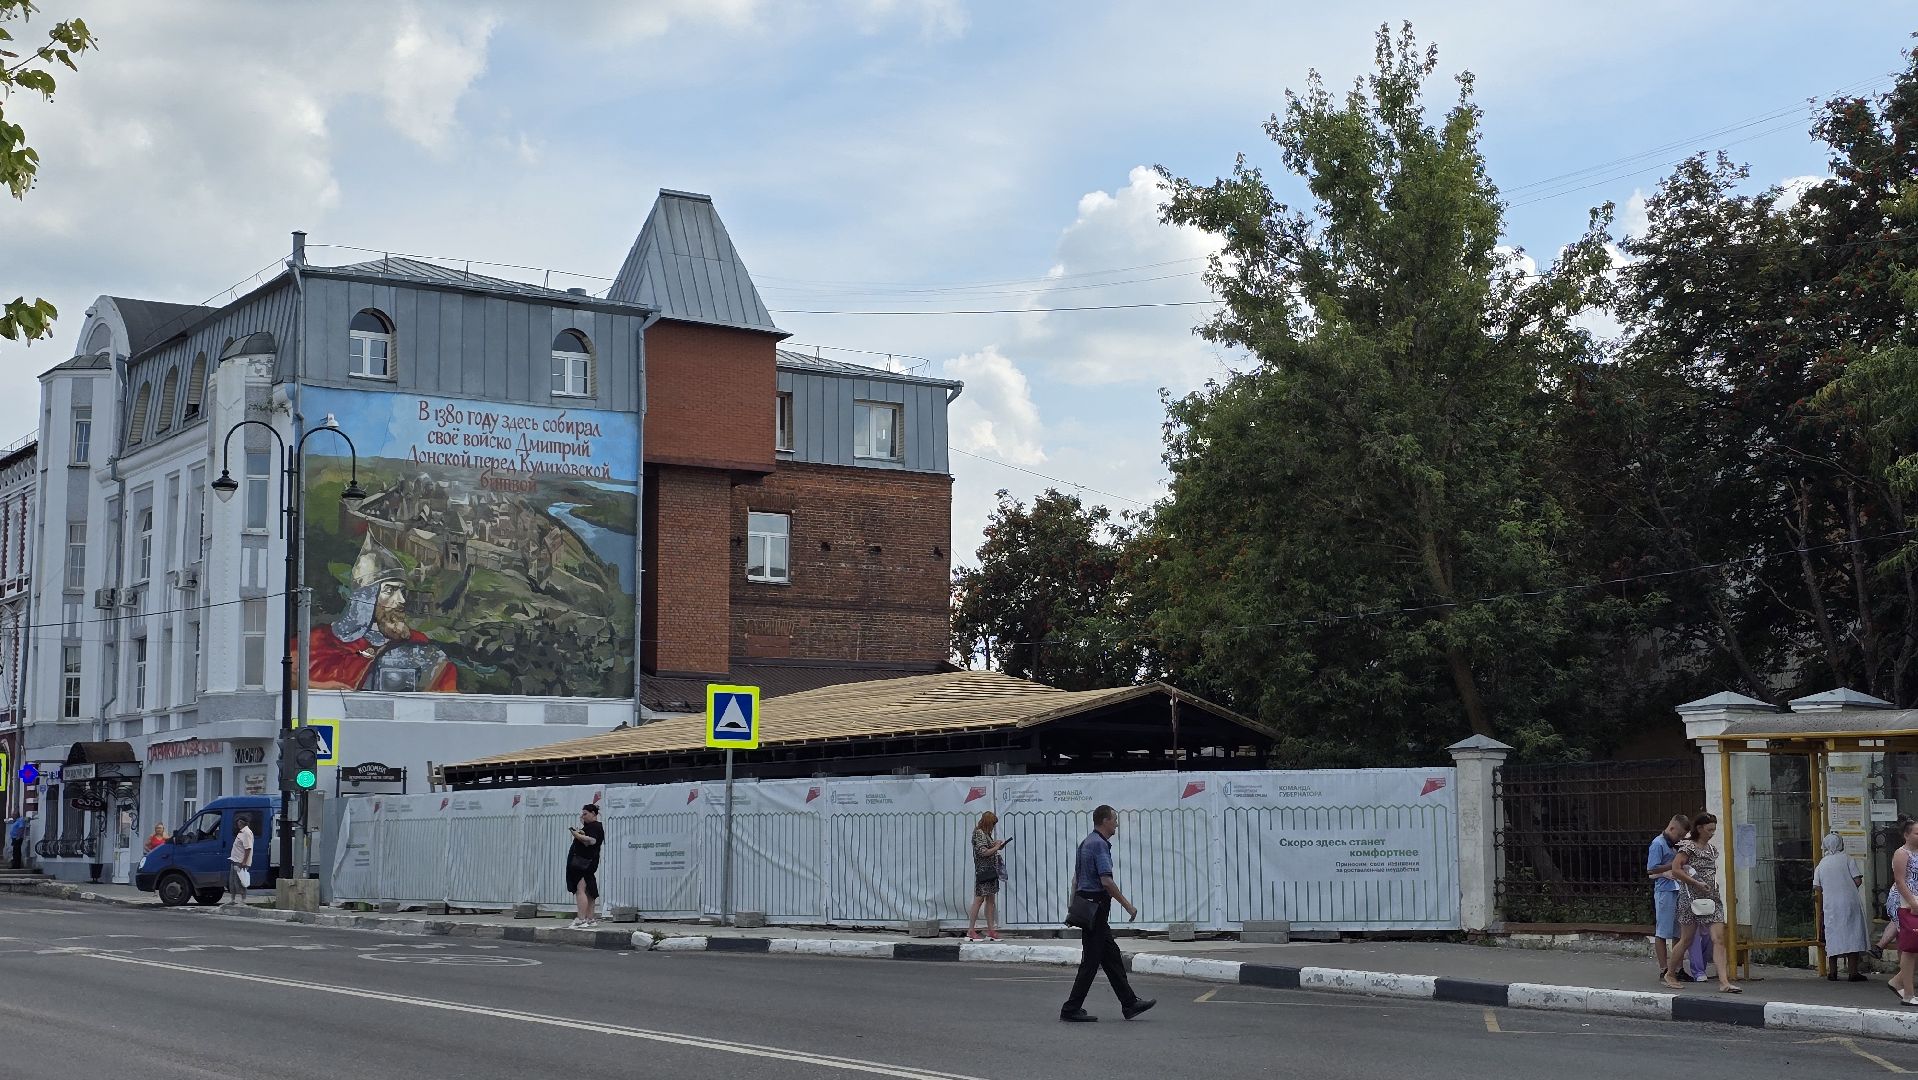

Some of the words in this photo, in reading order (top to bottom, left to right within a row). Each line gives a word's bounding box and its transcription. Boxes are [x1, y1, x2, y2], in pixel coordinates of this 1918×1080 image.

[418, 400, 430, 421] В
[434, 403, 464, 428] 1380
[467, 410, 500, 434] году
[501, 415, 539, 433] здесь
[542, 410, 603, 440] собирал
[427, 427, 460, 446] своё
[463, 431, 512, 450] войско
[515, 432, 592, 462] Дмитрий
[406, 444, 472, 467] Донской
[473, 454, 518, 476] перед
[519, 453, 612, 480] Куликовской
[480, 468, 537, 494] битвой
[357, 764, 387, 775] КОЛОМНА
[1279, 838, 1314, 848] Скоро
[1315, 838, 1347, 848] здесь
[1349, 838, 1387, 847] станет
[1350, 848, 1420, 858] комфортнее
